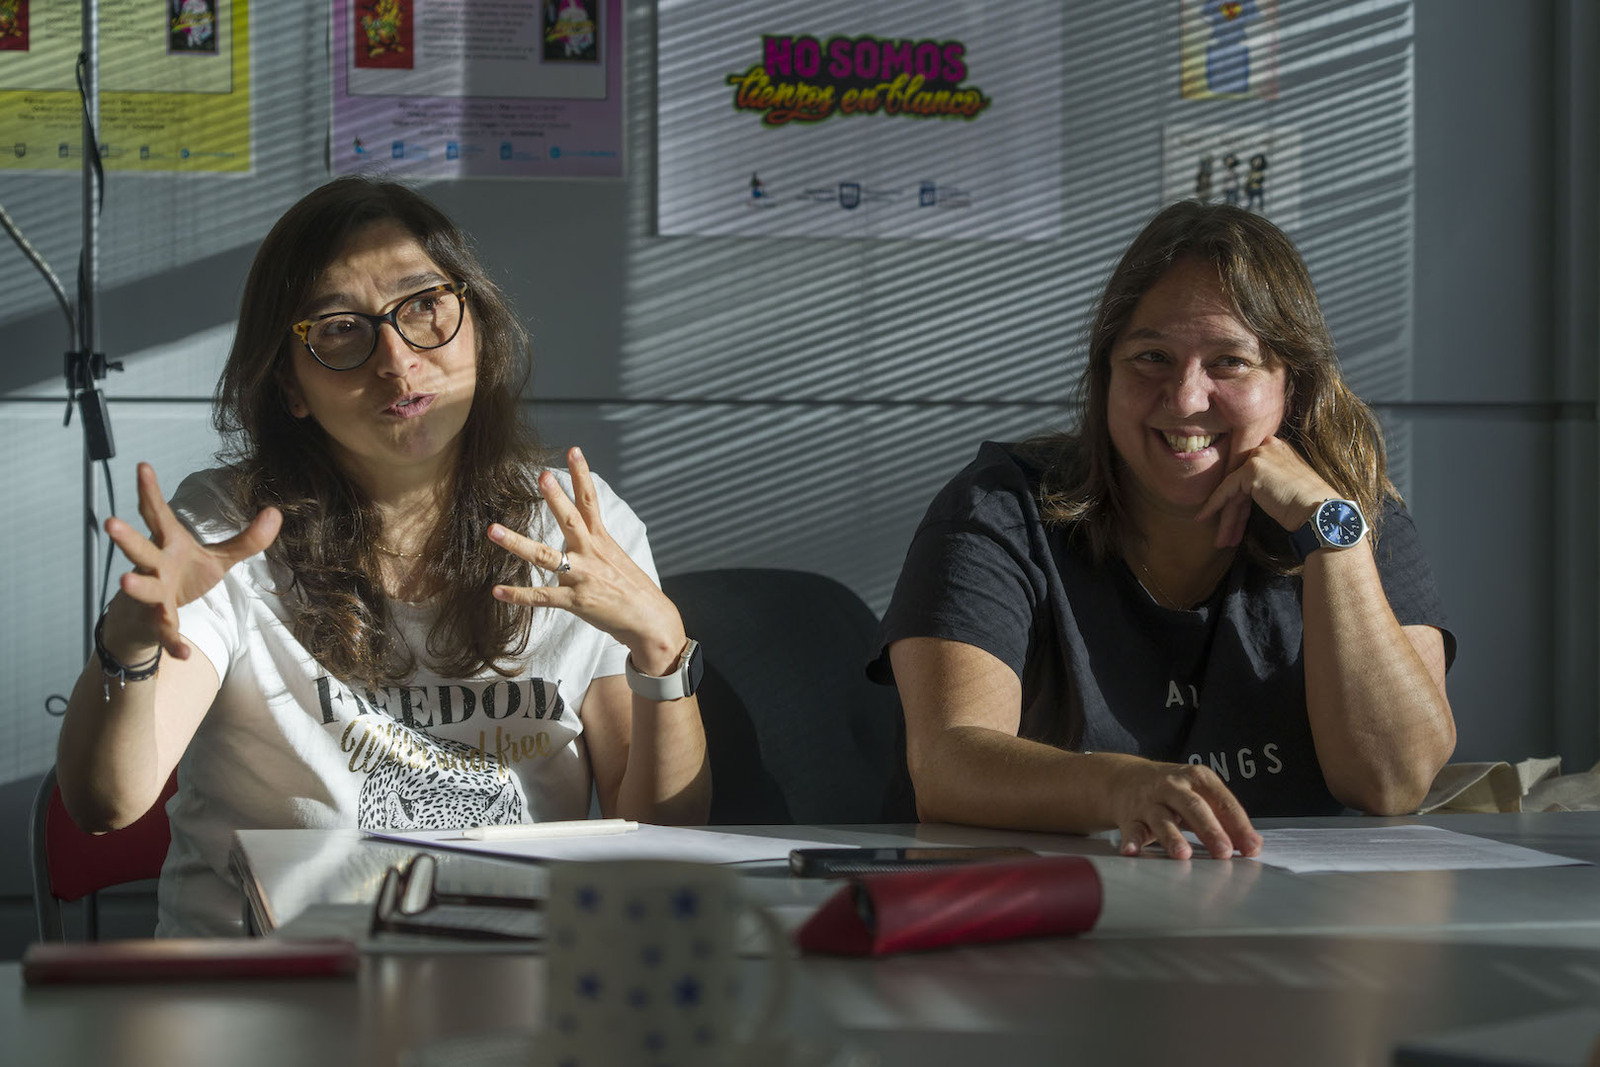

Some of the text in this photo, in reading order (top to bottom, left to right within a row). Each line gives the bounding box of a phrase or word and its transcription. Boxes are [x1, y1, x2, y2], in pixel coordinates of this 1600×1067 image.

[763, 36, 967, 82] NO SOMOS
[841, 86, 880, 115] en
[876, 73, 989, 116] blanco
[496, 726, 552, 784] free
